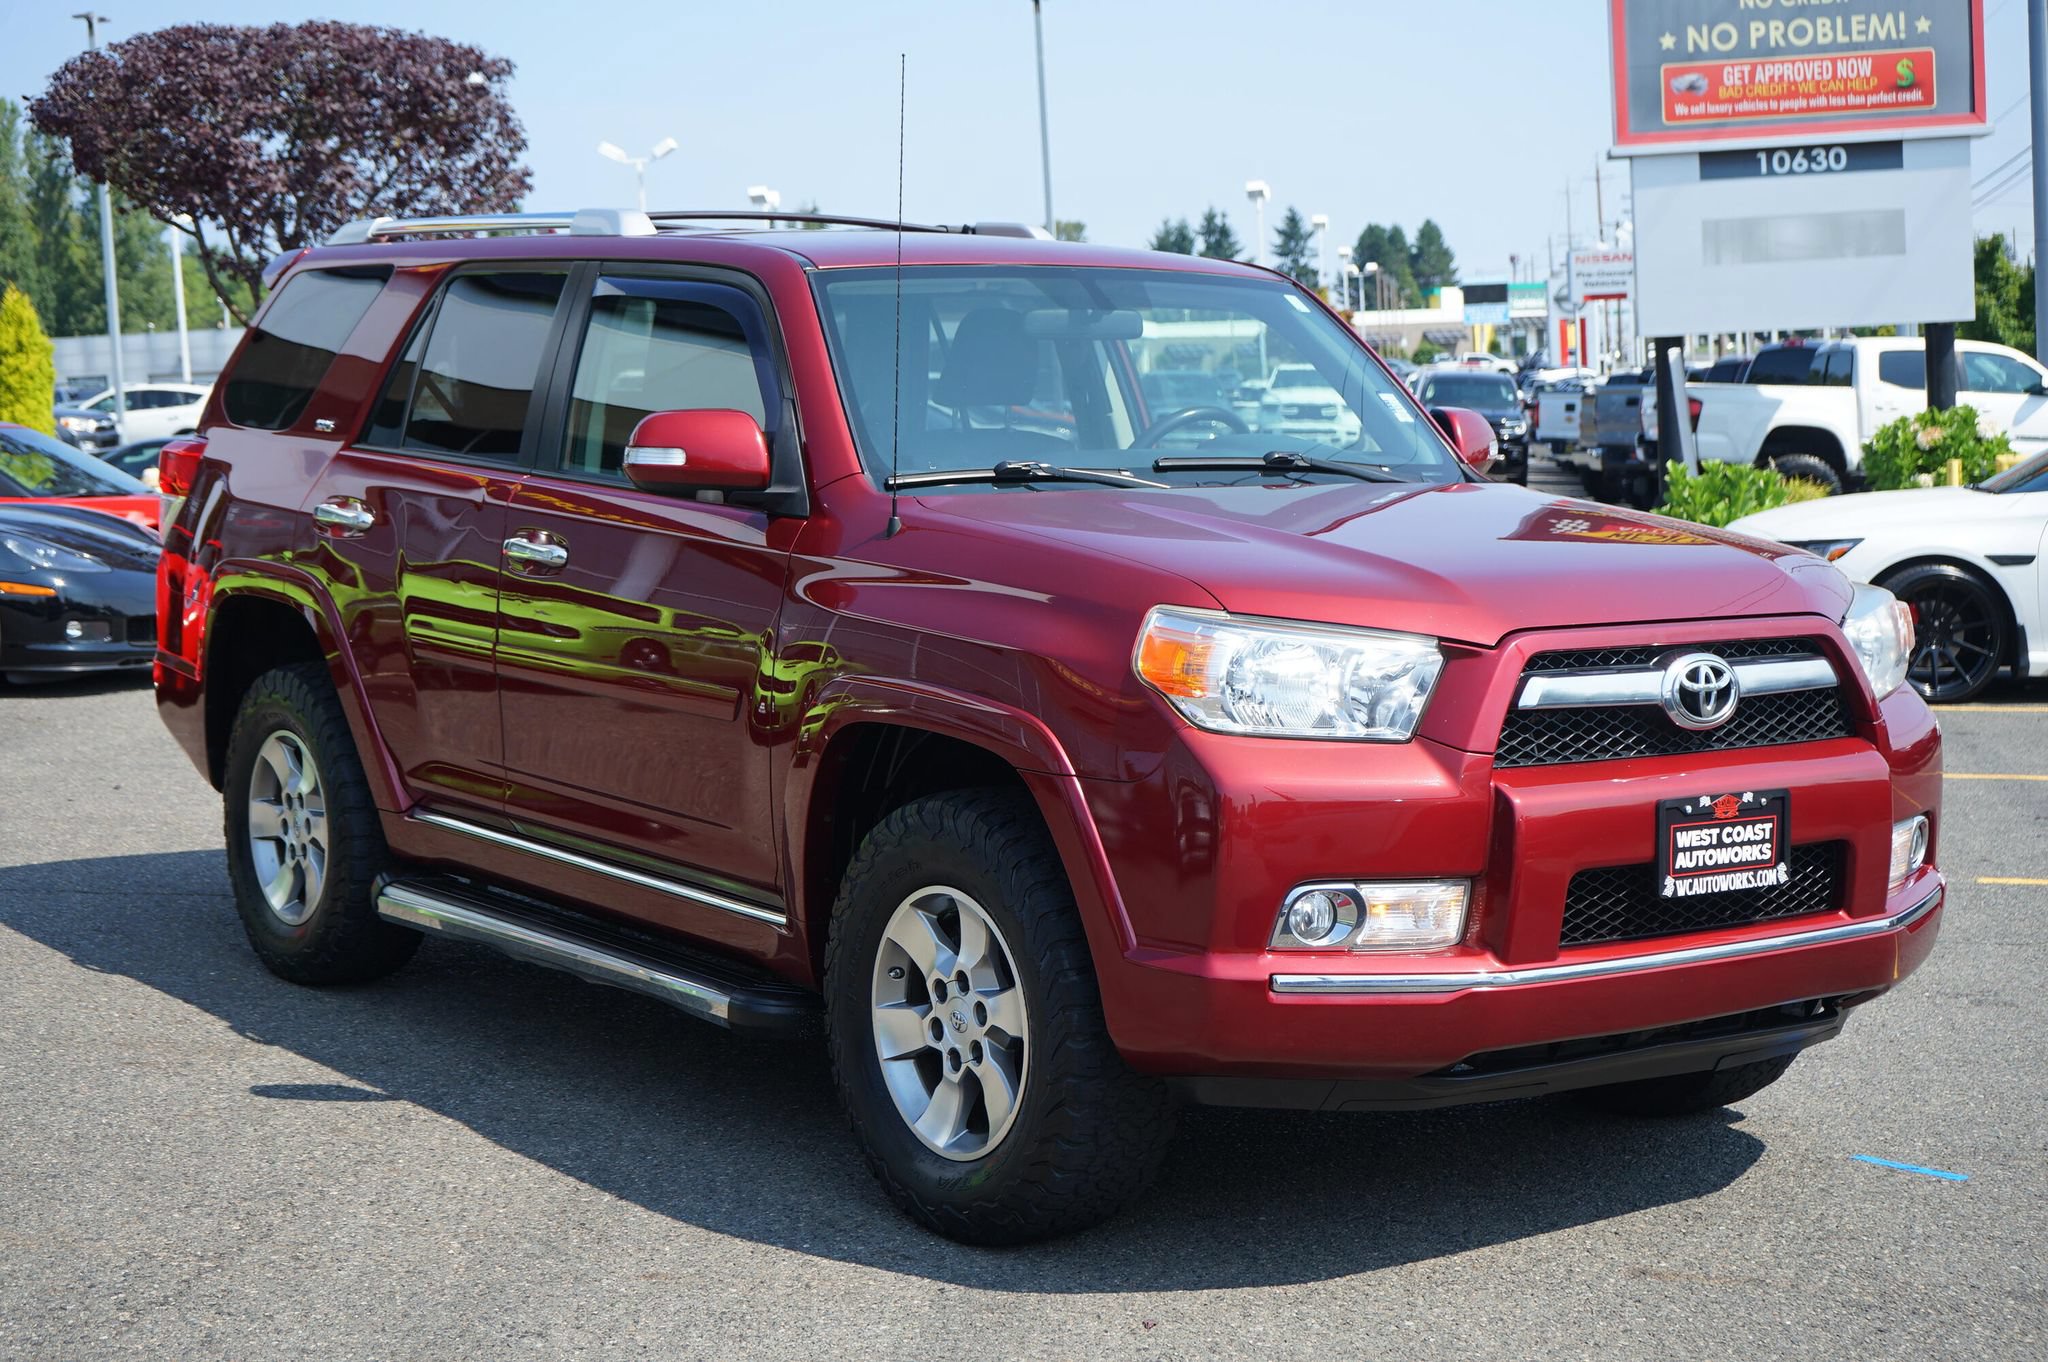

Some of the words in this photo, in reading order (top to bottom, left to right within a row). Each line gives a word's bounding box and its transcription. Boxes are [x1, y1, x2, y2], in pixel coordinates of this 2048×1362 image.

[1687, 22, 1738, 53] NO
[1750, 11, 1906, 50] PROBLEM!
[1723, 64, 1751, 86] GET
[1755, 60, 1832, 84] APPROVED
[1837, 57, 1872, 79] NOW
[1719, 85, 1743, 98] BAD
[1746, 82, 1788, 97] CREDIT
[1798, 80, 1816, 93] WE
[1820, 78, 1844, 92] CAN
[1847, 76, 1878, 91] HELP
[1675, 102, 1689, 116] We
[1734, 98, 1768, 112] vehicles
[1770, 98, 1778, 110] to
[1780, 95, 1807, 112] people
[1809, 93, 1827, 107] with
[1829, 93, 1845, 106] less
[1847, 91, 1865, 105] than
[1867, 89, 1896, 107] perfect
[1756, 146, 1847, 175] 10630
[1676, 828, 1720, 848] WEST
[1722, 823, 1773, 843] COAST
[1675, 843, 1772, 869] AUTOWORKS
[1676, 869, 1777, 897] WCAUTOWORKS.COM
